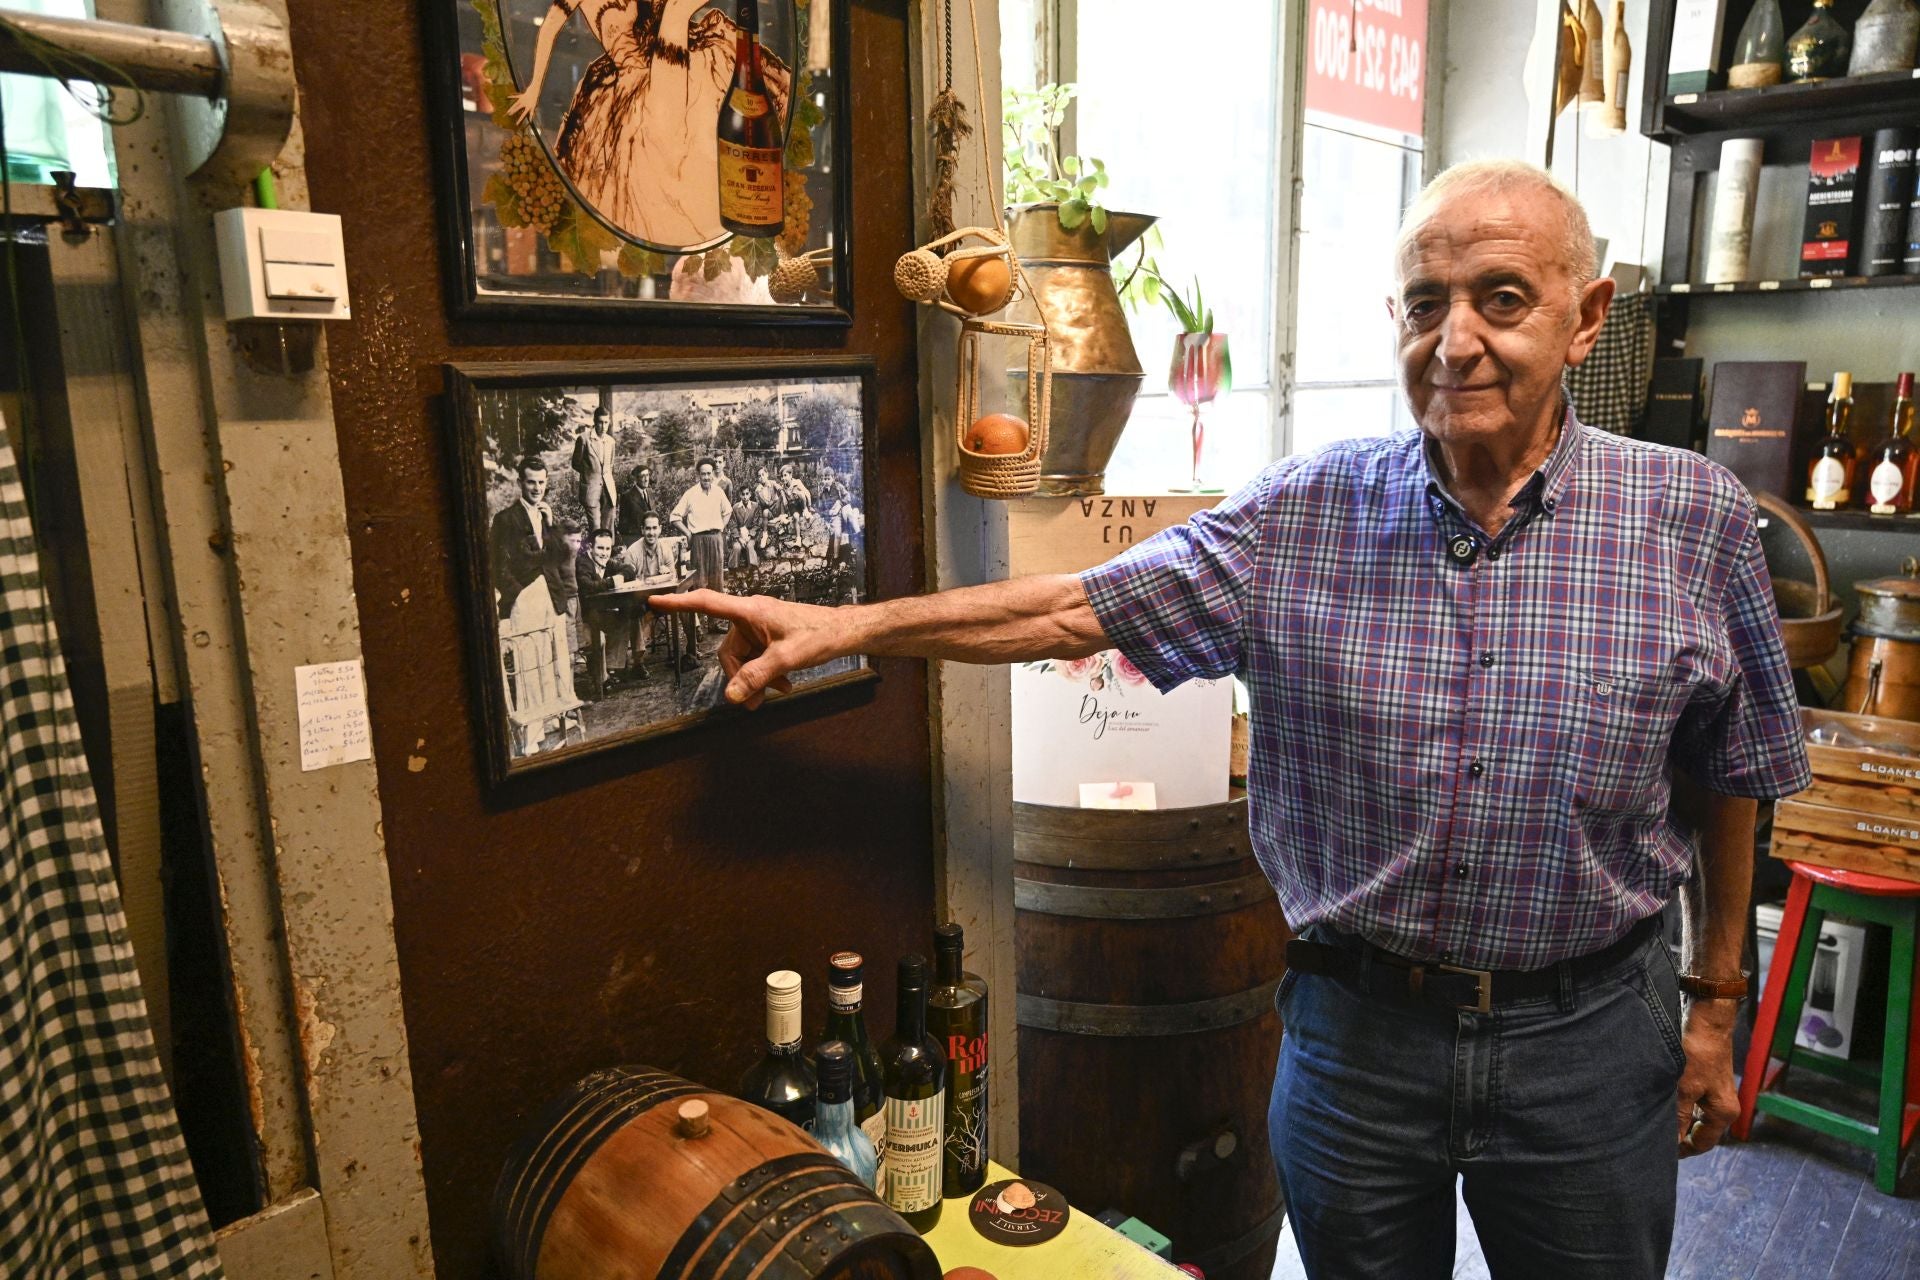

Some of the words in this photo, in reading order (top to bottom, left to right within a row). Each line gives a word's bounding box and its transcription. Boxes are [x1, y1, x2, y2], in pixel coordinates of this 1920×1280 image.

[726, 145, 777, 162] TORRES
[727, 179, 745, 189] GRAN
[747, 184, 776, 192] RESERVA
[1861, 762, 1920, 779] SLOANE'S
[1857, 822, 1919, 840] SLOANE'S
[885, 1137, 938, 1153] VERMUKA
